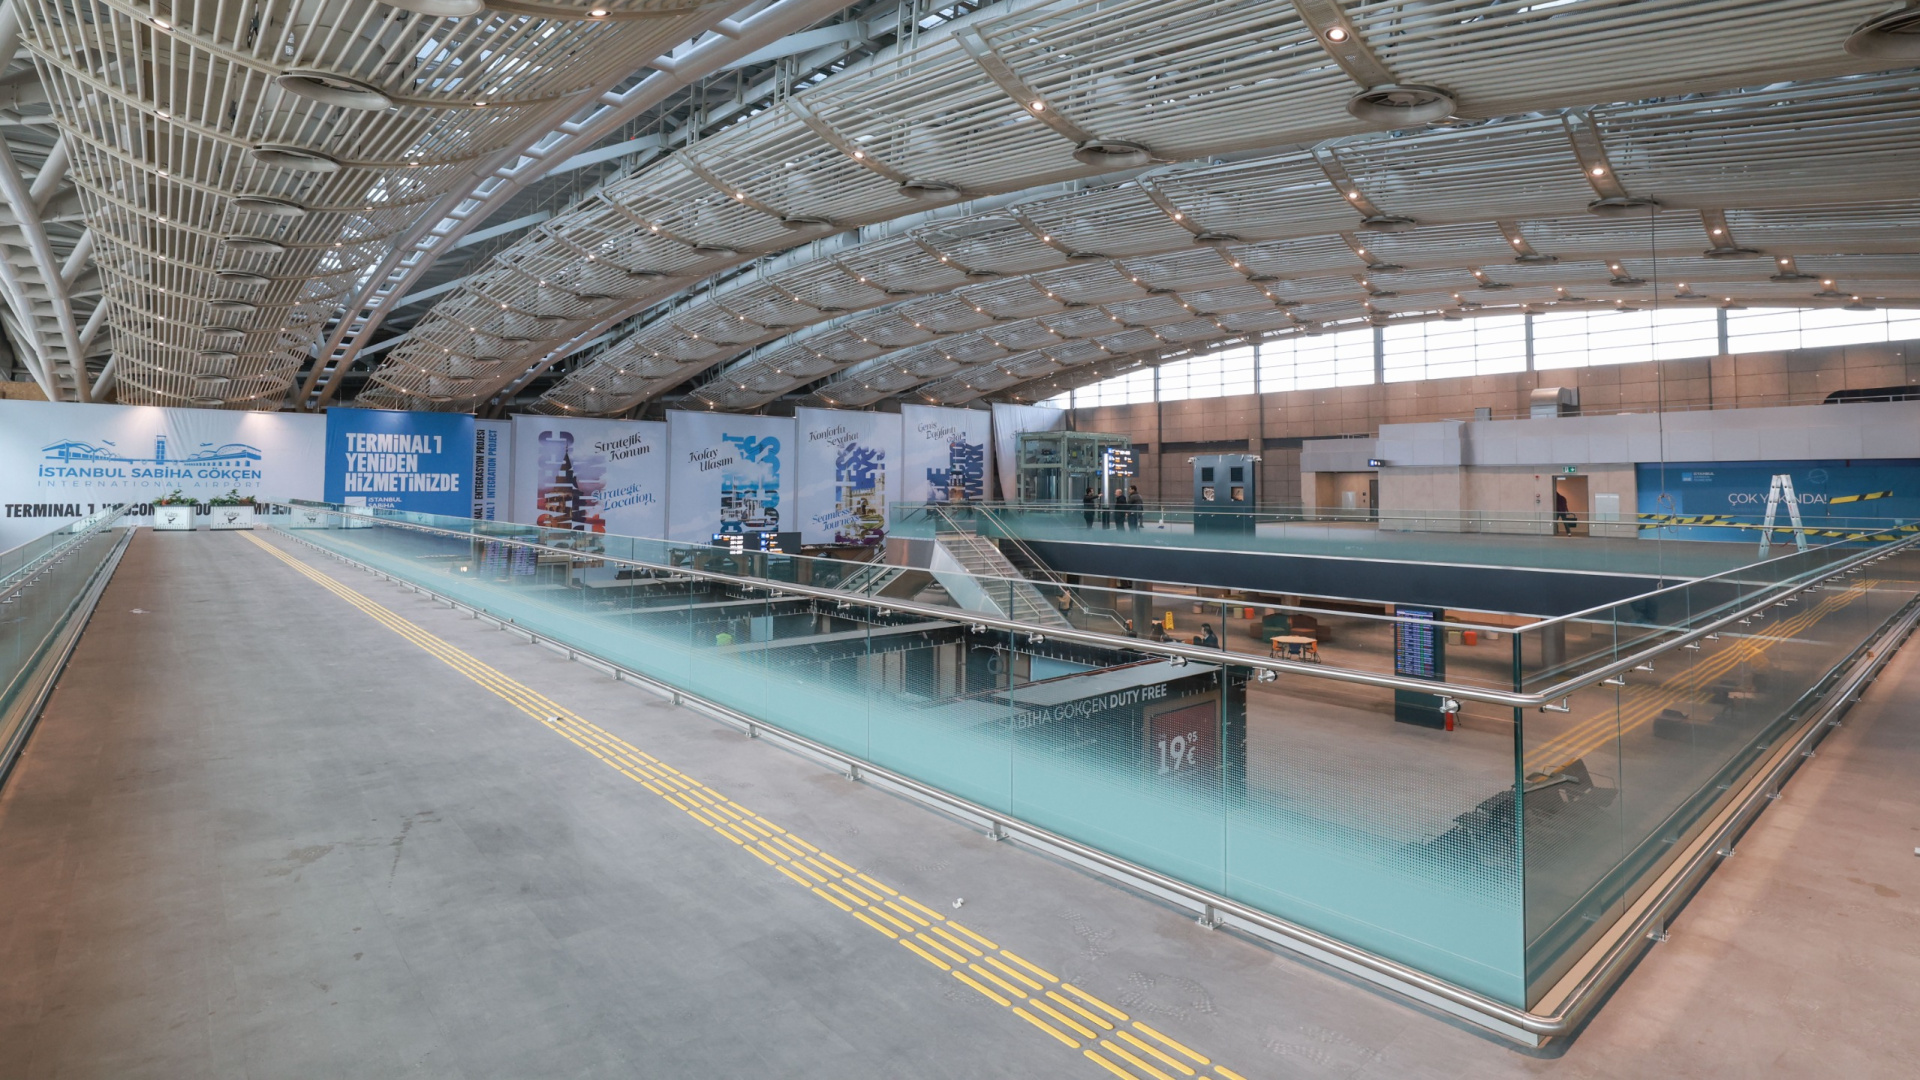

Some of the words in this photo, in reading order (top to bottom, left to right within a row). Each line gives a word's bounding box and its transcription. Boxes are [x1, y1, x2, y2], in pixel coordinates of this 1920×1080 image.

[488, 429, 497, 456] PROJECT
[594, 432, 642, 453] Stratejik
[609, 445, 650, 462] Konum
[688, 447, 718, 463] Kolay
[131, 466, 193, 479] SABİHA
[198, 467, 262, 482] GÖKÇEN
[487, 457, 497, 498] INTEGRATION
[38, 480, 182, 488] INTERNATIONAL
[1728, 493, 1758, 506] ÇOK
[1760, 493, 1827, 504] YKNDA!
[5, 503, 82, 517] TERMINAL
[1110, 688, 1140, 708] DUTY
[1142, 683, 1168, 701] FREE
